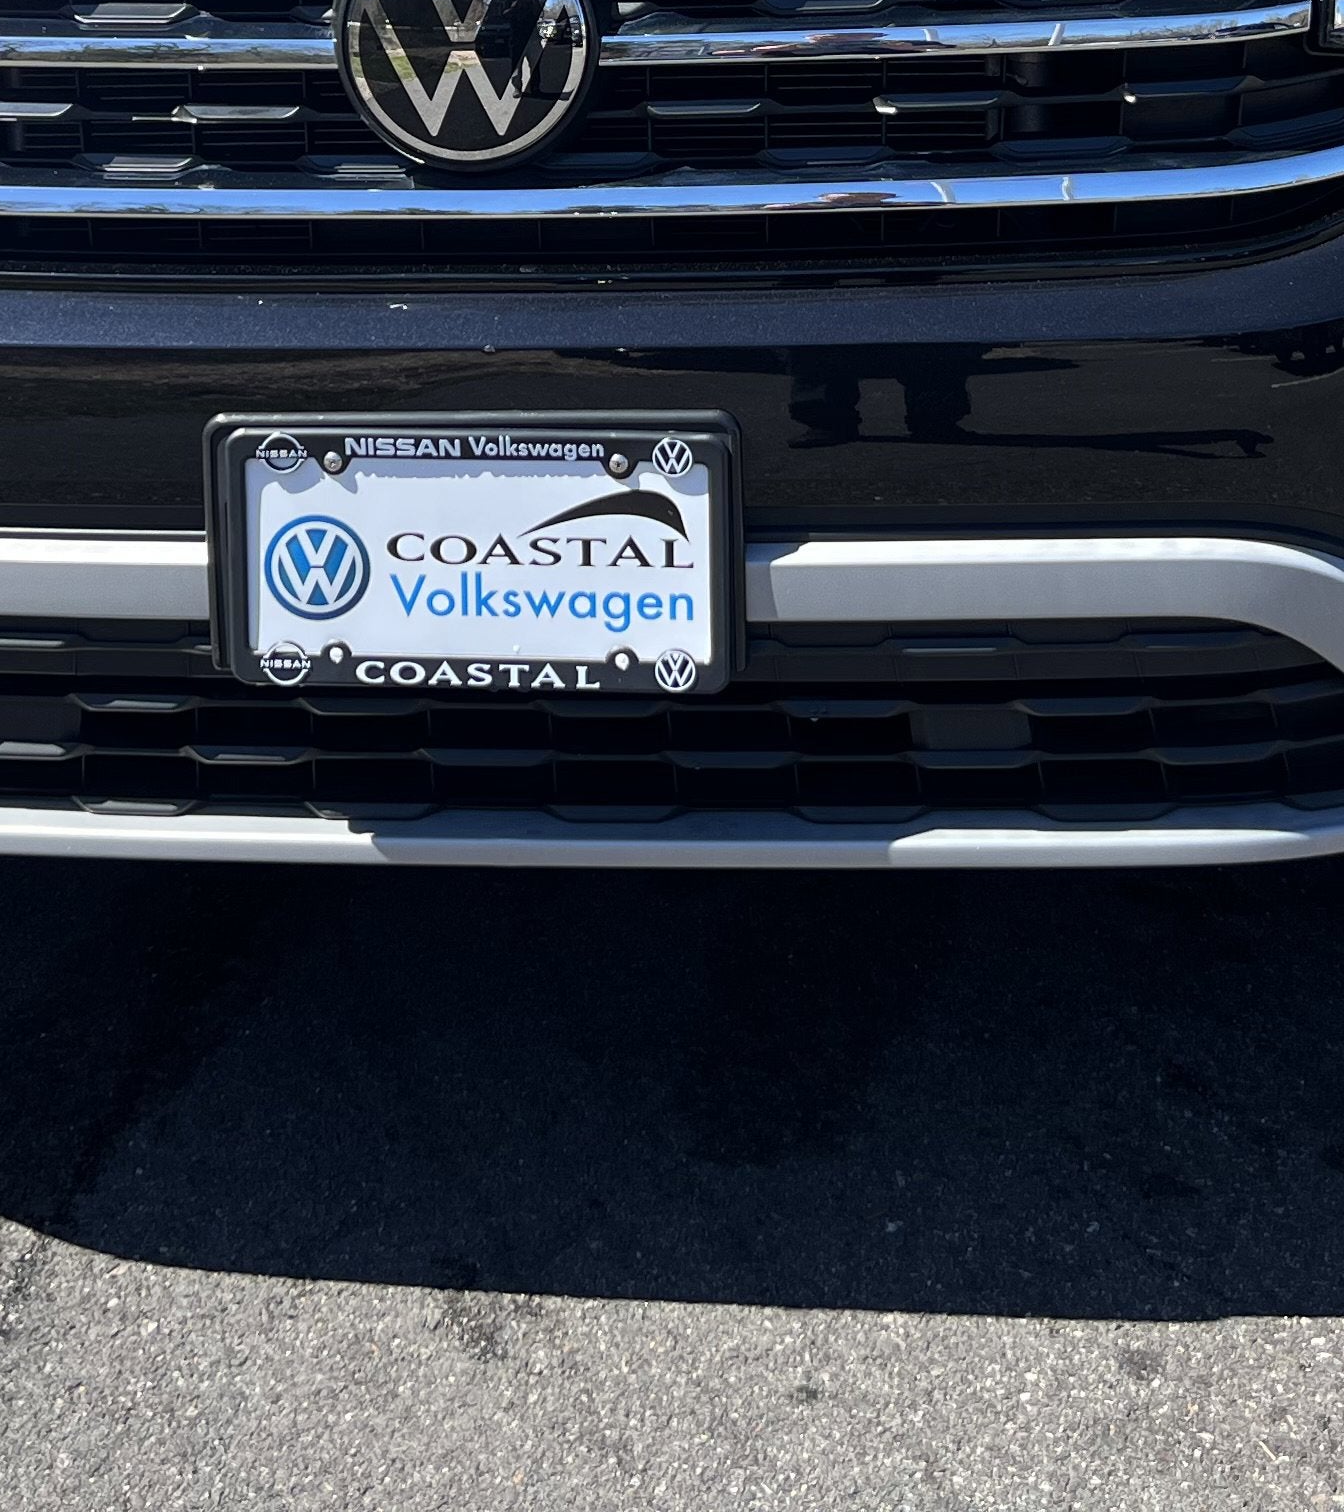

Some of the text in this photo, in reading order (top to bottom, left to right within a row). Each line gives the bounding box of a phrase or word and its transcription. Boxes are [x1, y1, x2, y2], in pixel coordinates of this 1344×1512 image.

[255, 449, 308, 459] NISSAN
[345, 436, 605, 461] NISSAN Volkswagen
[386, 532, 694, 569] COASTAL
[268, 518, 367, 616] VW
[389, 571, 695, 633] Volkswagen
[260, 658, 311, 669] NISSAN
[355, 660, 600, 690] COASTAL
